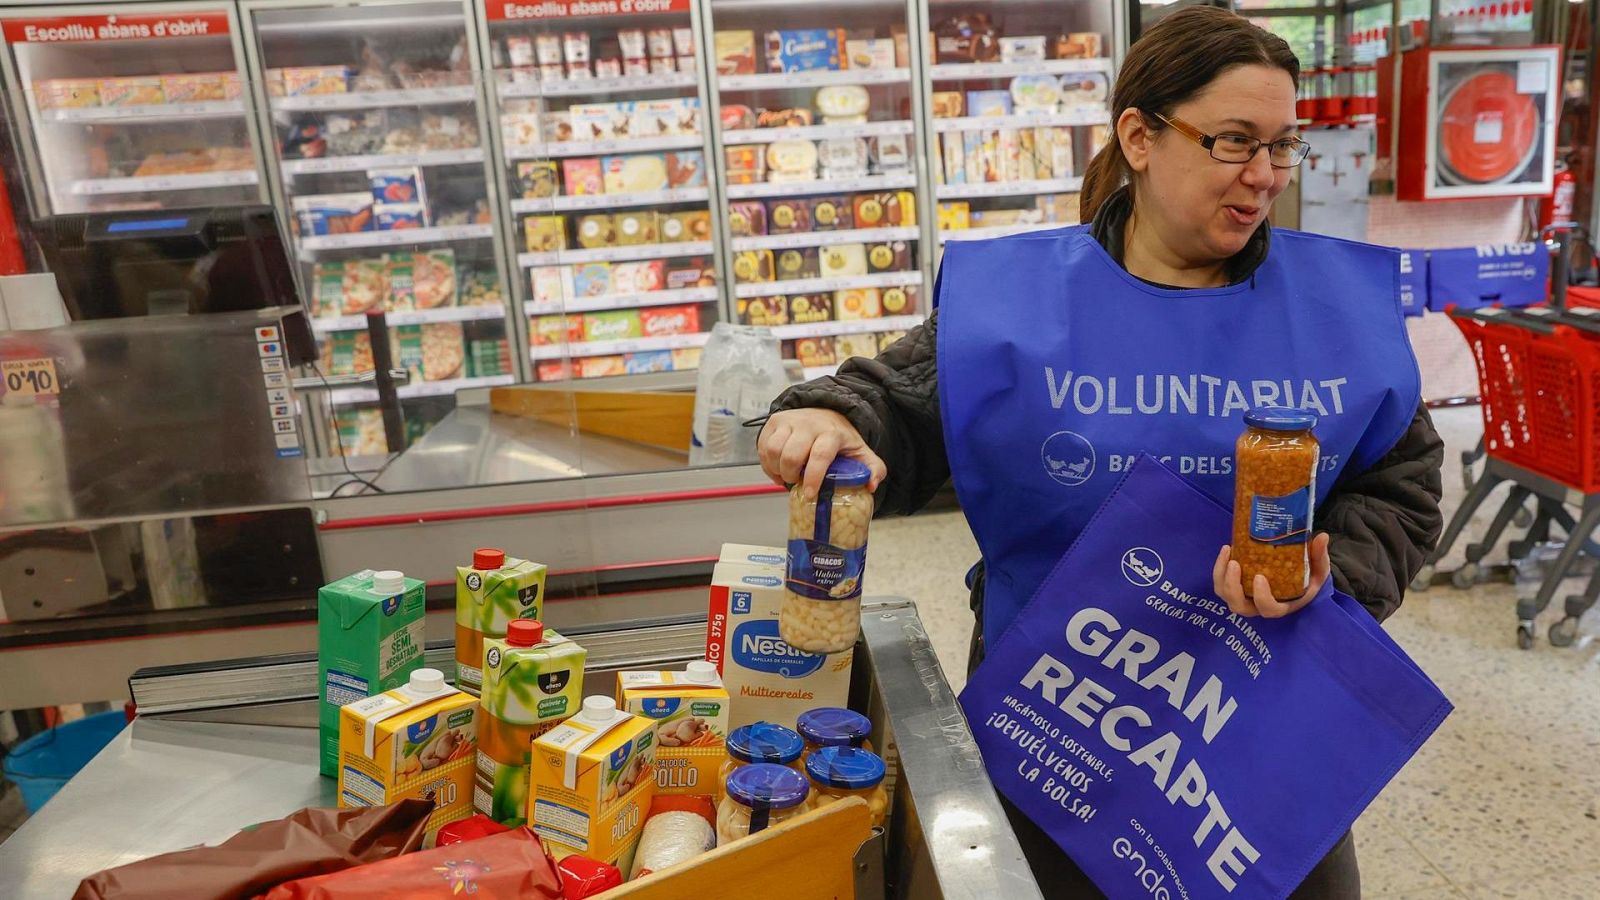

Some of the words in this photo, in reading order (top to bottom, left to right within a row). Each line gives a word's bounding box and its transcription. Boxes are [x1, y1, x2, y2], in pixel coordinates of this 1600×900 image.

[504, 3, 567, 18] Escolliu
[570, 0, 618, 15] abans
[620, 0, 672, 12] d'obrir
[24, 24, 95, 41] Escolliu
[99, 23, 151, 39] abans
[153, 18, 209, 36] d'obrir
[1045, 367, 1347, 417] VOLUNTARIAT
[1109, 454, 1172, 472] BAC
[1180, 457, 1232, 474] DELS
[737, 597, 746, 608] 6
[1145, 595, 1188, 620] GRACIAS
[1186, 613, 1209, 628] POR
[1209, 622, 1226, 637] LA
[711, 614, 725, 638] 375g
[1160, 581, 1198, 605] BANC
[1196, 599, 1228, 616] DELS
[1226, 613, 1272, 665] ALIMENTS
[391, 633, 412, 656] SEMI
[740, 685, 814, 700] Multicereales
[1065, 607, 1238, 745] GRAN
[985, 712, 1093, 793] ¡DEVUÉLVENOS
[1003, 695, 1060, 738] HAGÁMOSLO
[1059, 734, 1115, 782] SOSTENIBLE,
[1018, 759, 1040, 782] LA
[1041, 777, 1097, 823] BOLSA!
[1019, 653, 1262, 893] RECAPTE
[611, 807, 639, 846] POLLO
[1130, 819, 1146, 836] con
[1145, 834, 1154, 846] la
